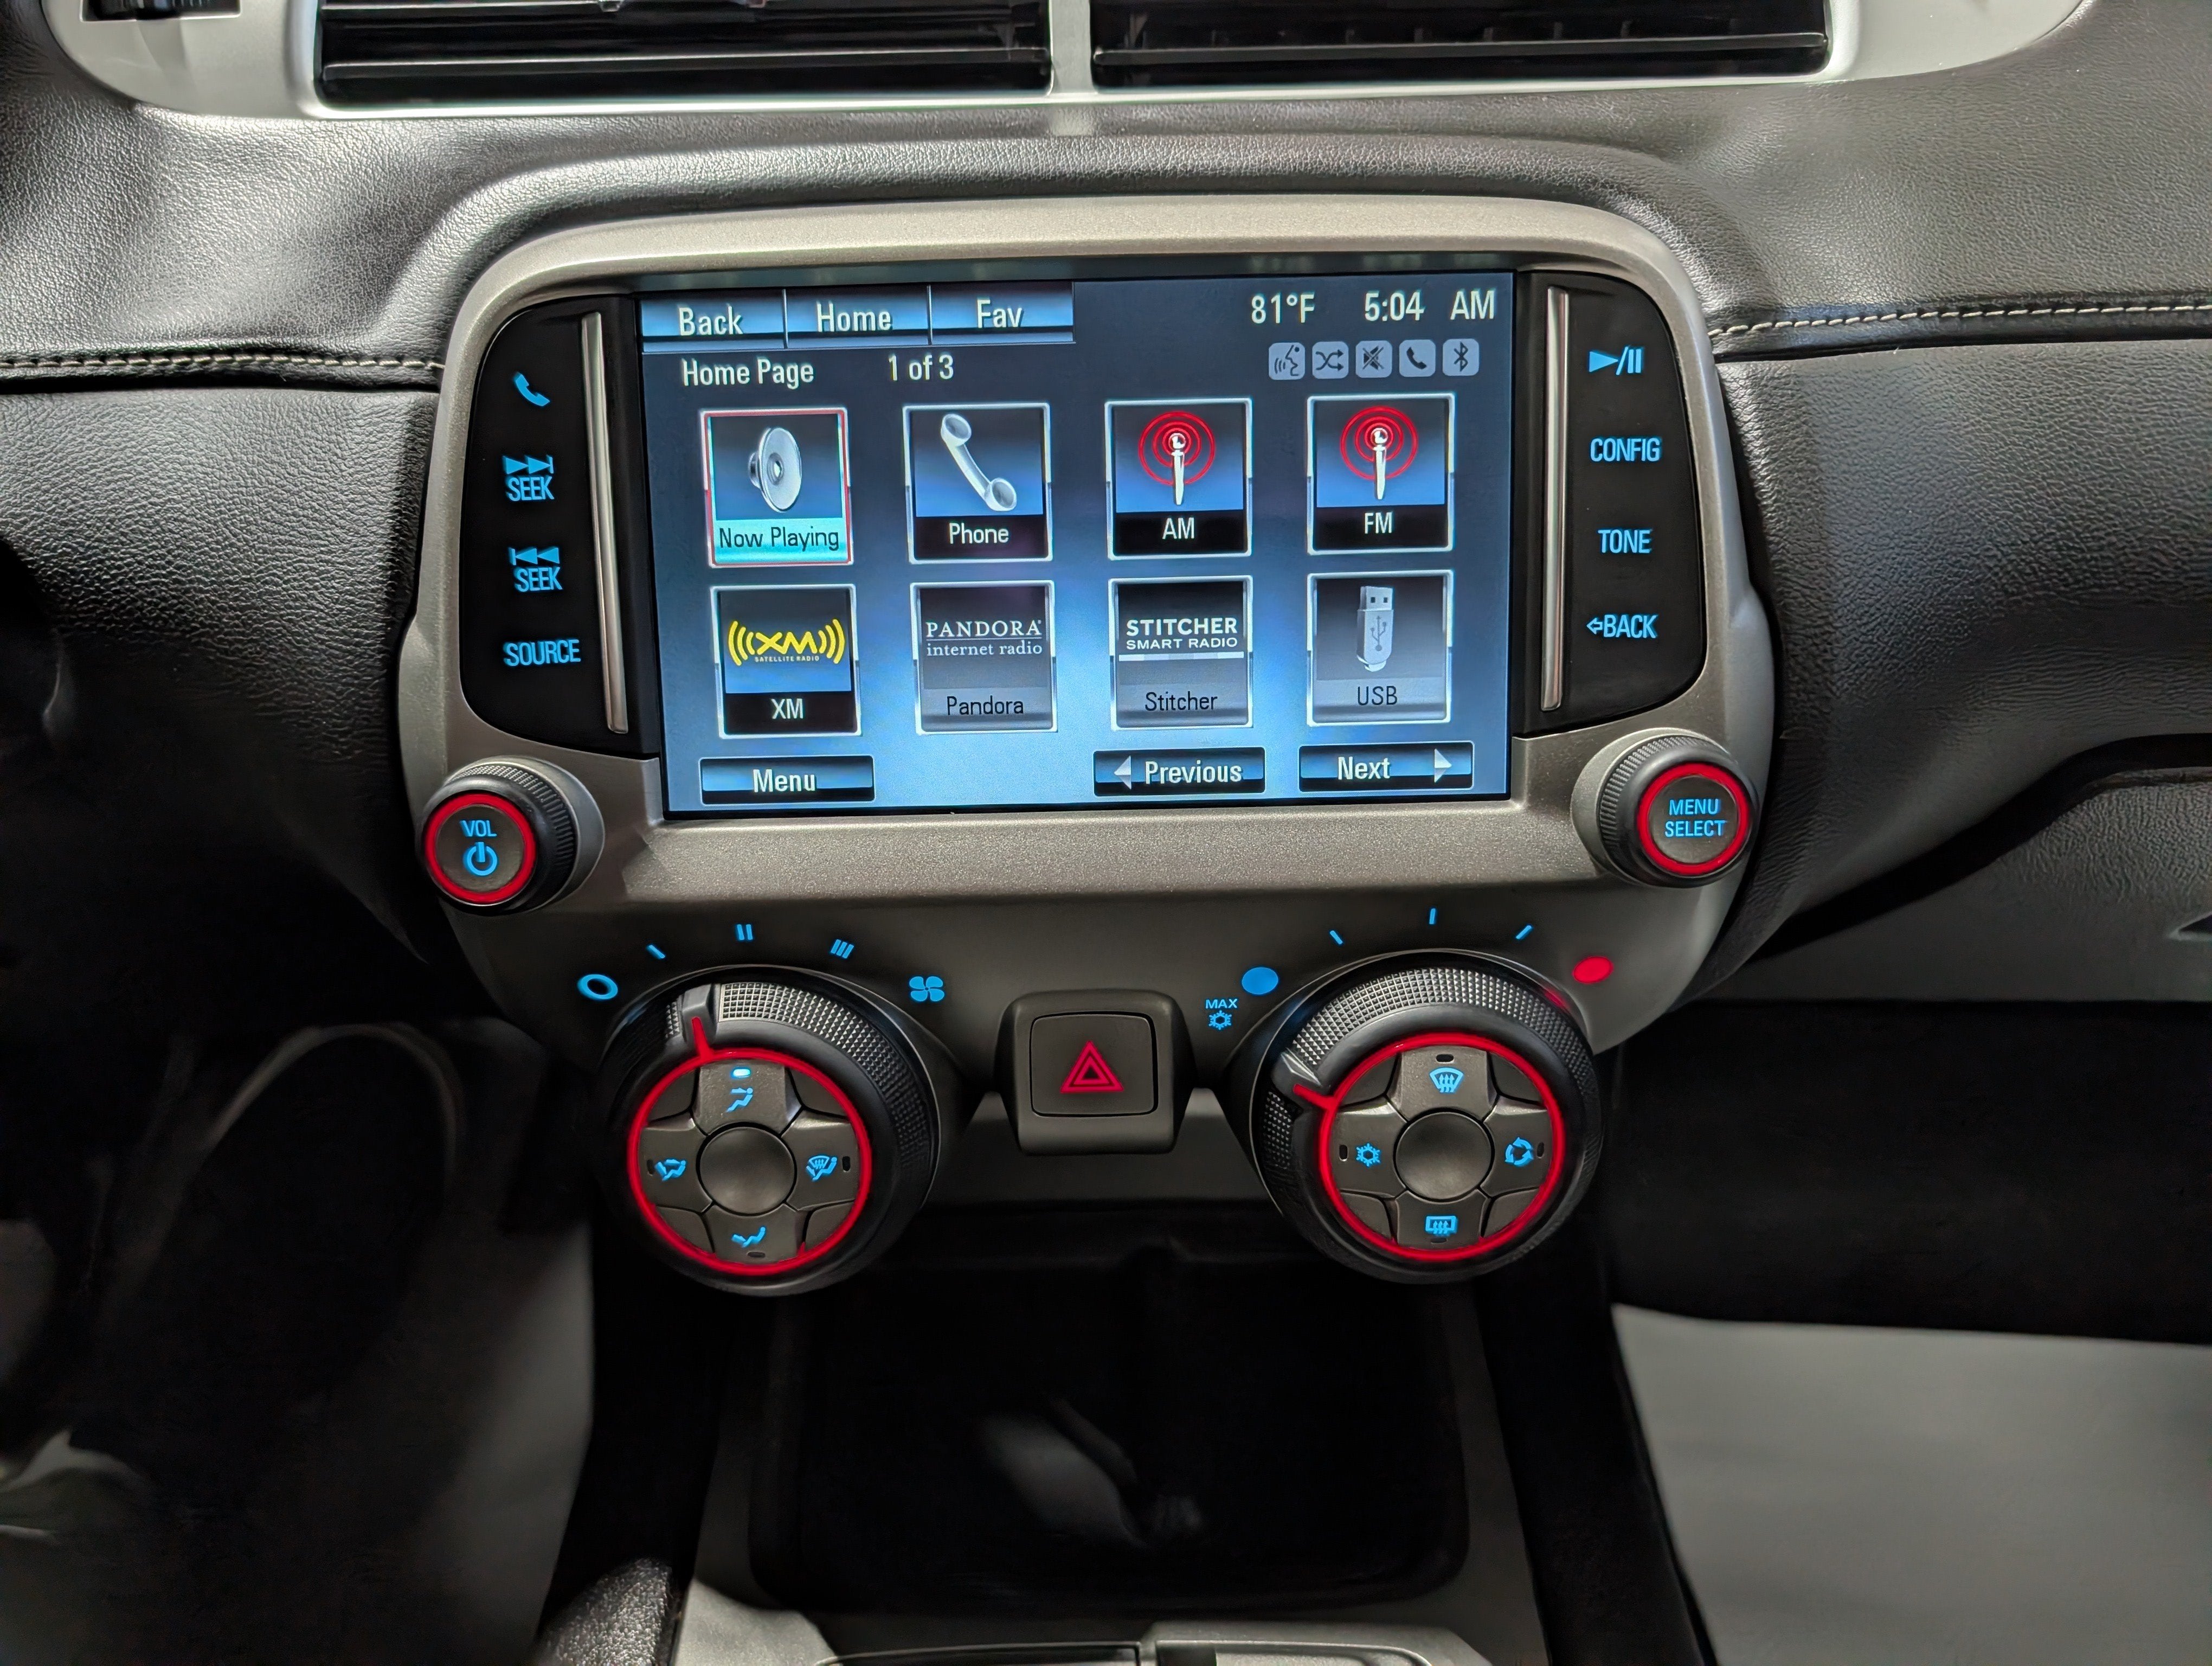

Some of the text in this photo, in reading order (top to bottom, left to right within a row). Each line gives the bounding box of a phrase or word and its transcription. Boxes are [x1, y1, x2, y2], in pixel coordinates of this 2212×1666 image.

[816, 302, 892, 332] Home
[977, 299, 1024, 329] Fav
[1251, 293, 1315, 324] 81°F
[1364, 290, 1495, 321] 5:04 AM
[678, 304, 743, 336] Back
[681, 357, 814, 389] Home Page
[888, 354, 954, 381] 1 of 3
[1590, 437, 1662, 463] CONFIG
[504, 476, 555, 501] SEEK
[949, 522, 1009, 544] Phone
[1162, 517, 1195, 540] AM
[1364, 512, 1393, 534] FM
[719, 525, 839, 551] Now Playing
[1598, 528, 1652, 554] TONE
[513, 566, 563, 592] SEEK
[925, 620, 1043, 638] PANDORA
[1126, 617, 1238, 637] STITCHER
[1603, 614, 1657, 639] BACK
[503, 639, 581, 667] SOURCE
[755, 631, 817, 653] XM
[926, 639, 1043, 656] internet radio
[1126, 637, 1238, 650] SMART RADIO
[947, 695, 1024, 716] Pandora
[1144, 691, 1218, 712] Stitcher
[1357, 685, 1398, 706] USB
[771, 698, 804, 720] XM
[1145, 760, 1243, 785] Previous
[1337, 756, 1391, 780] Next
[752, 768, 817, 793] Menu
[1669, 799, 1721, 816] MENU
[460, 819, 497, 837] VOL
[1664, 819, 1727, 837] SELECT
[1205, 998, 1238, 1009] MAX
